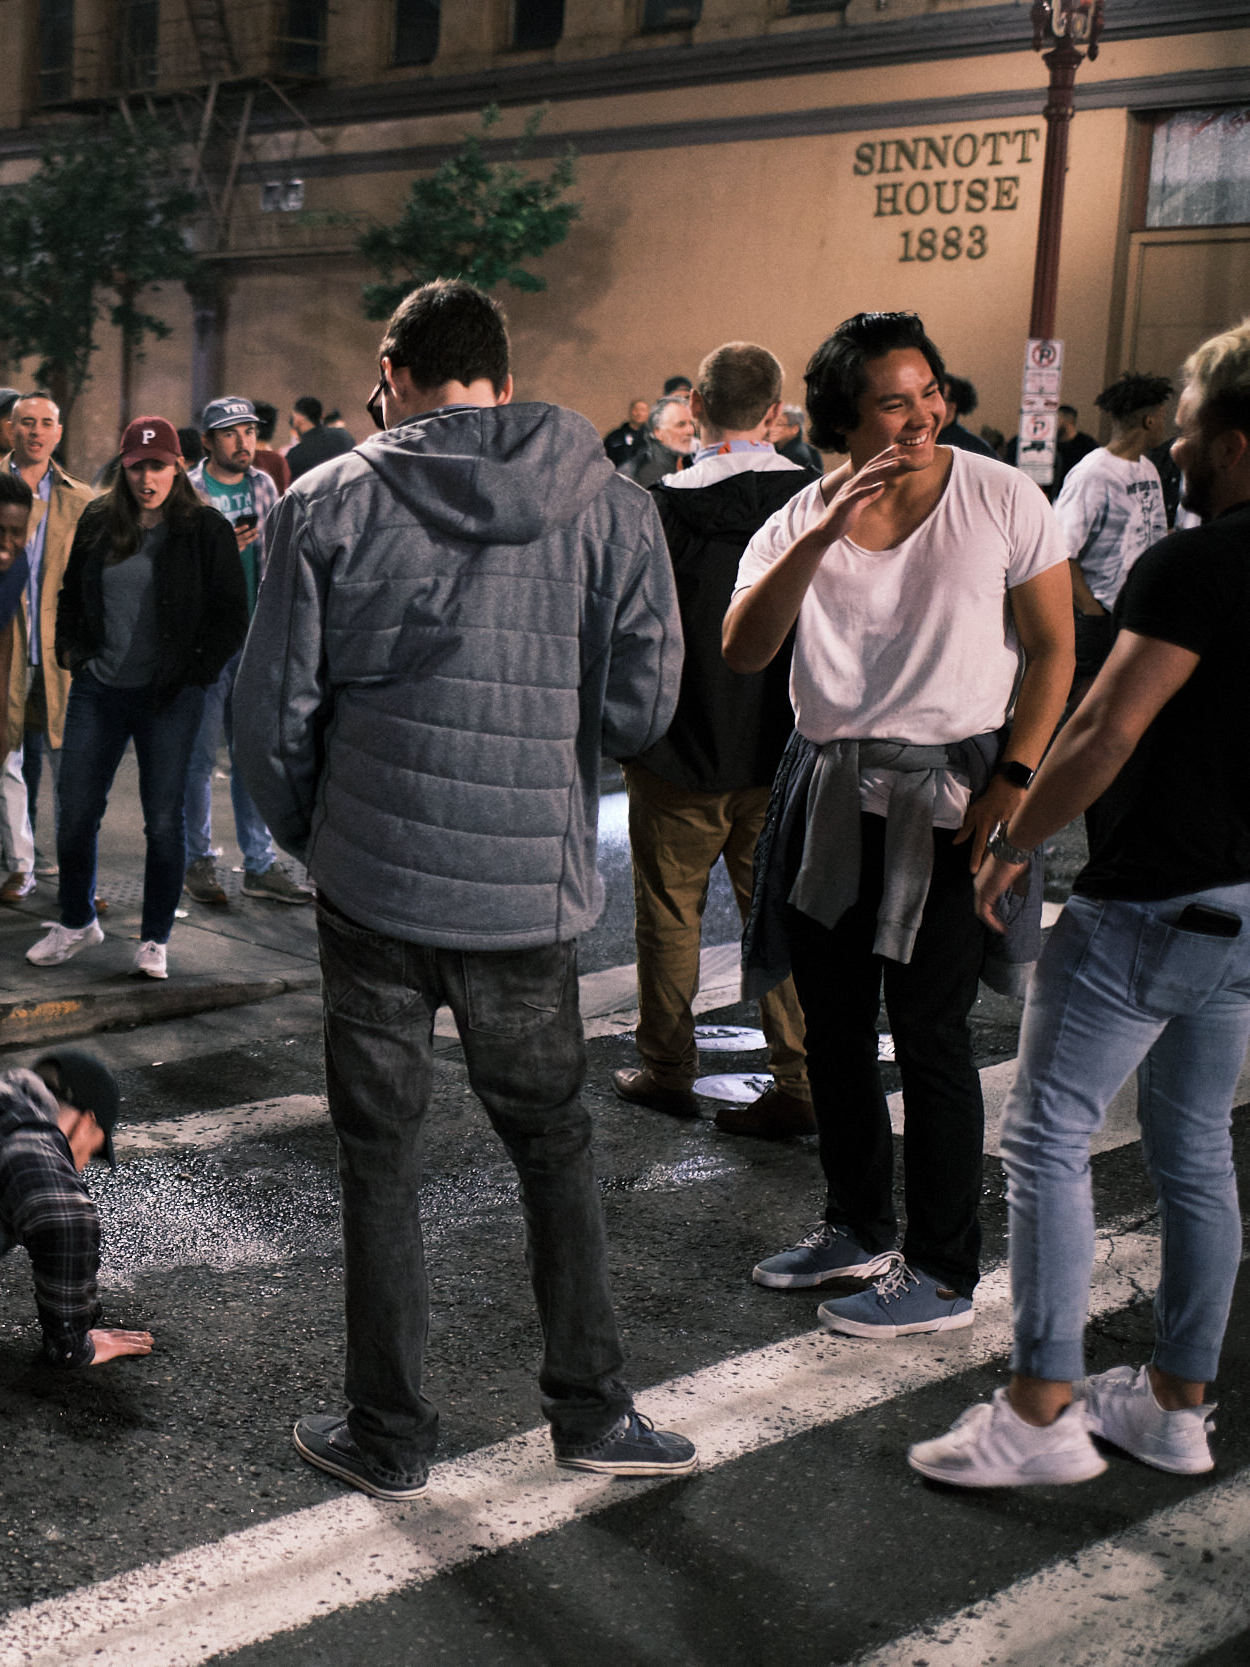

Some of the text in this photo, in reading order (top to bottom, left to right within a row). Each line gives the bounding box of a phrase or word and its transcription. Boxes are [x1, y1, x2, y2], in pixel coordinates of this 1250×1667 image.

[853, 128, 1040, 176] SINNOTT
[874, 176, 1020, 218] HOUSE
[898, 225, 988, 263] 1883
[223, 403, 249, 414] YETI
[141, 429, 156, 444] P
